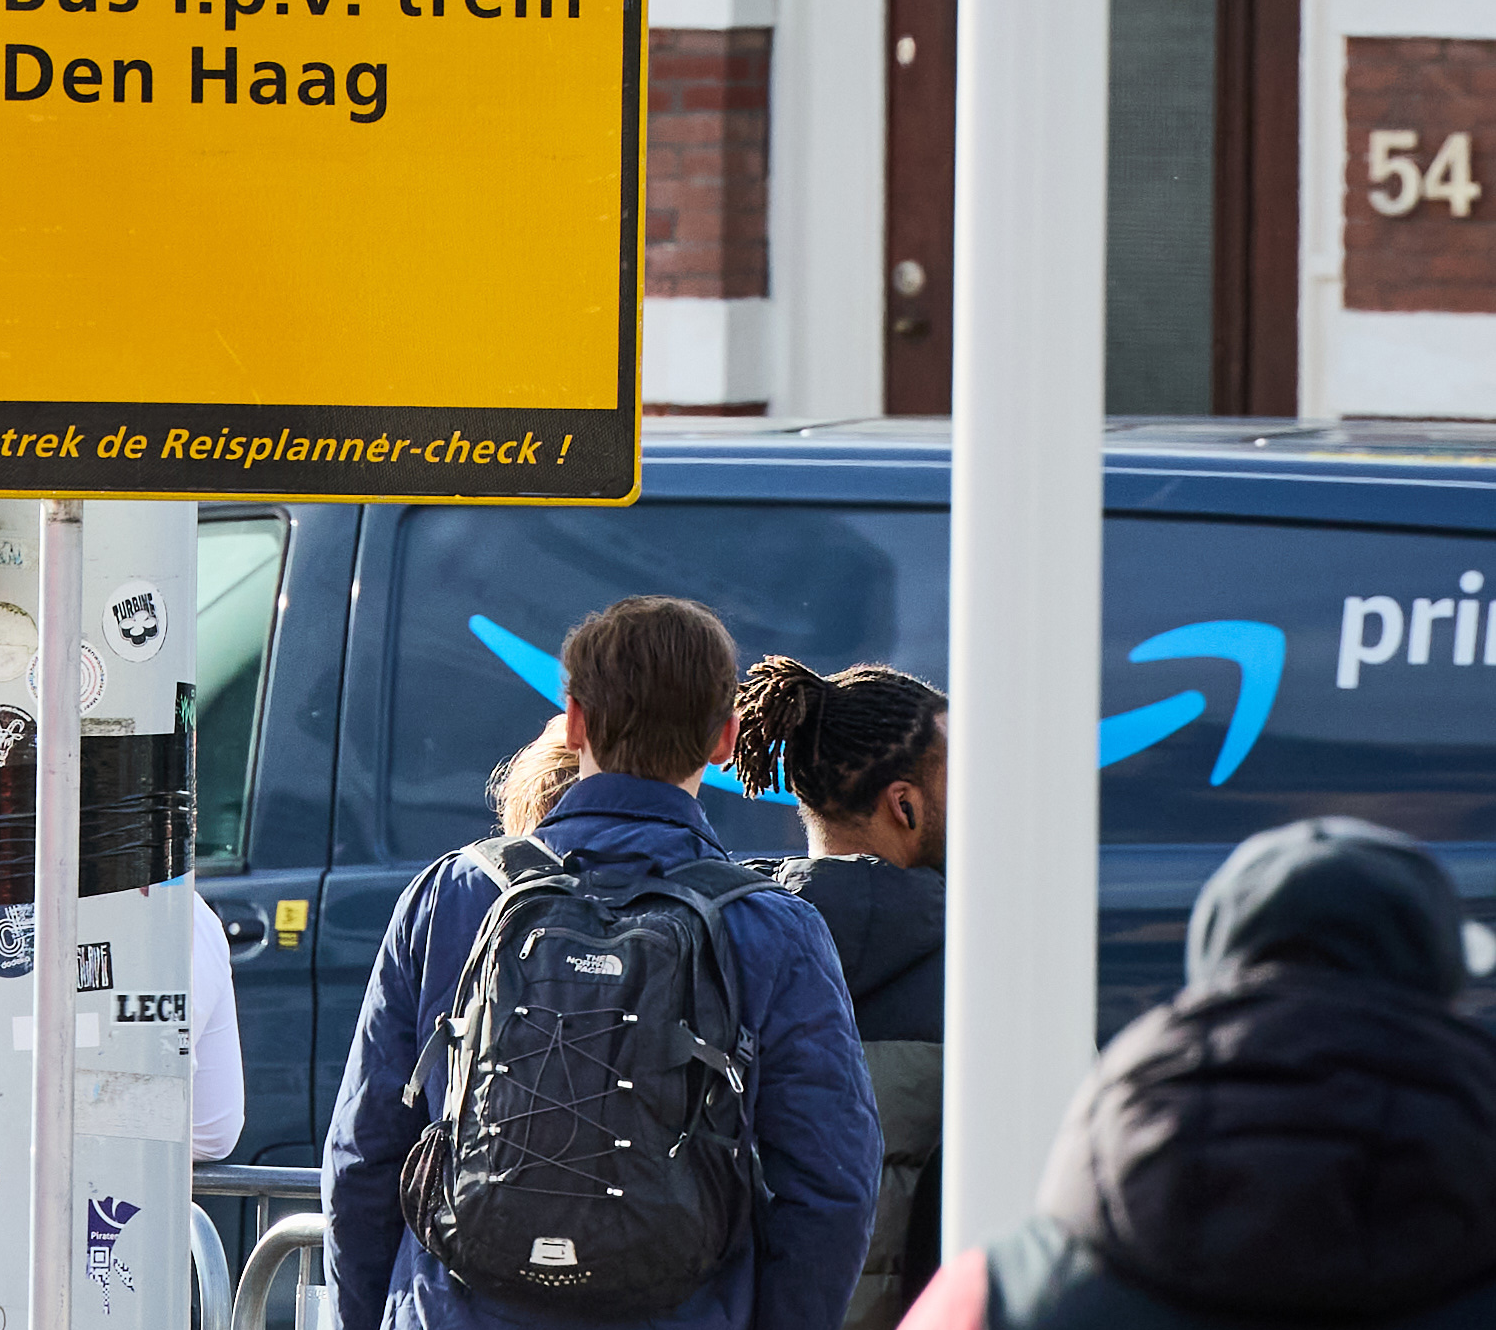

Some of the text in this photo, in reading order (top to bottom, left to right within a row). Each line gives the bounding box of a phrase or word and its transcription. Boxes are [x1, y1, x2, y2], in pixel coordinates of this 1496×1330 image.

[4, 43, 388, 124] Den Haag
[1367, 129, 1481, 217] 54
[96, 425, 148, 459] de
[160, 427, 543, 469] Reisplanner-check
[1336, 570, 1496, 690] pri
[574, 964, 603, 975] FACE
[585, 953, 607, 962] THE
